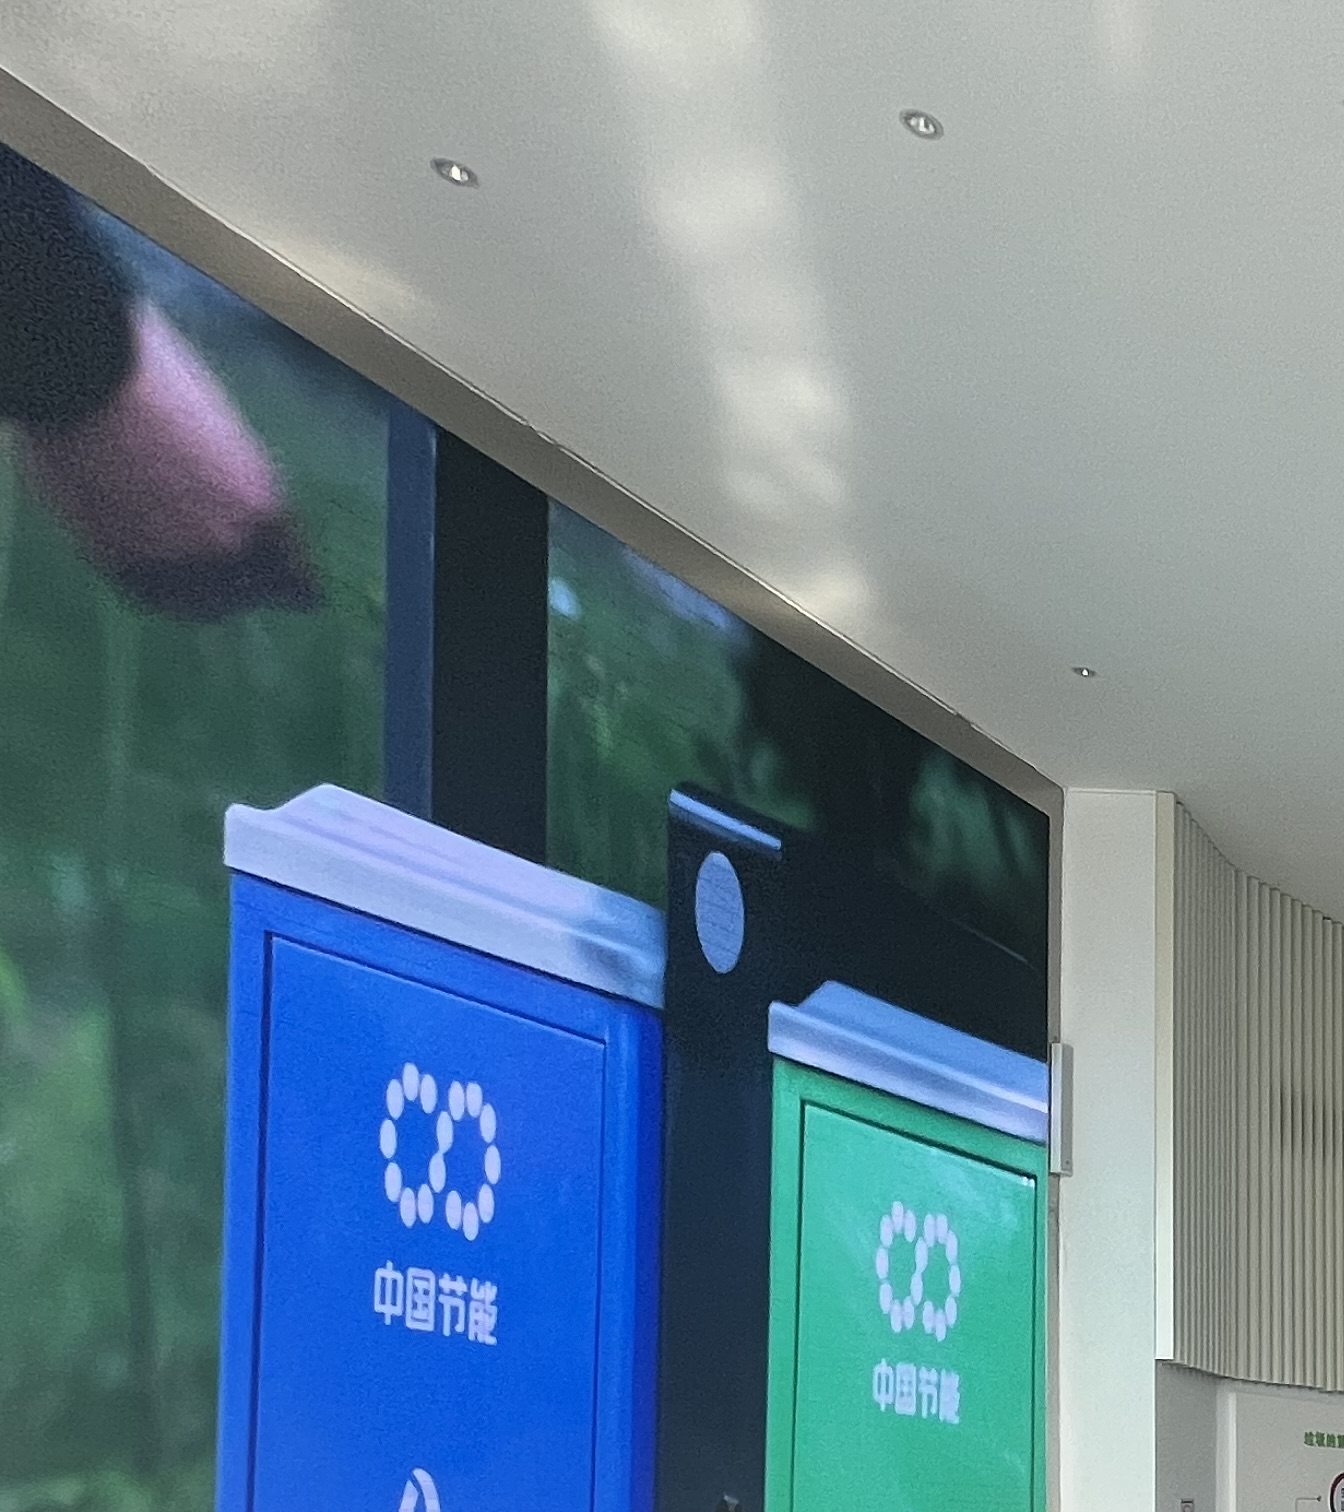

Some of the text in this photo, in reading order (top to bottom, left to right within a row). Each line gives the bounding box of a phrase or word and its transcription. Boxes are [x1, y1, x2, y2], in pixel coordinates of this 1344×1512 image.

[373, 1259, 498, 1346] 中国节能
[872, 1357, 961, 1425] 中国节能
